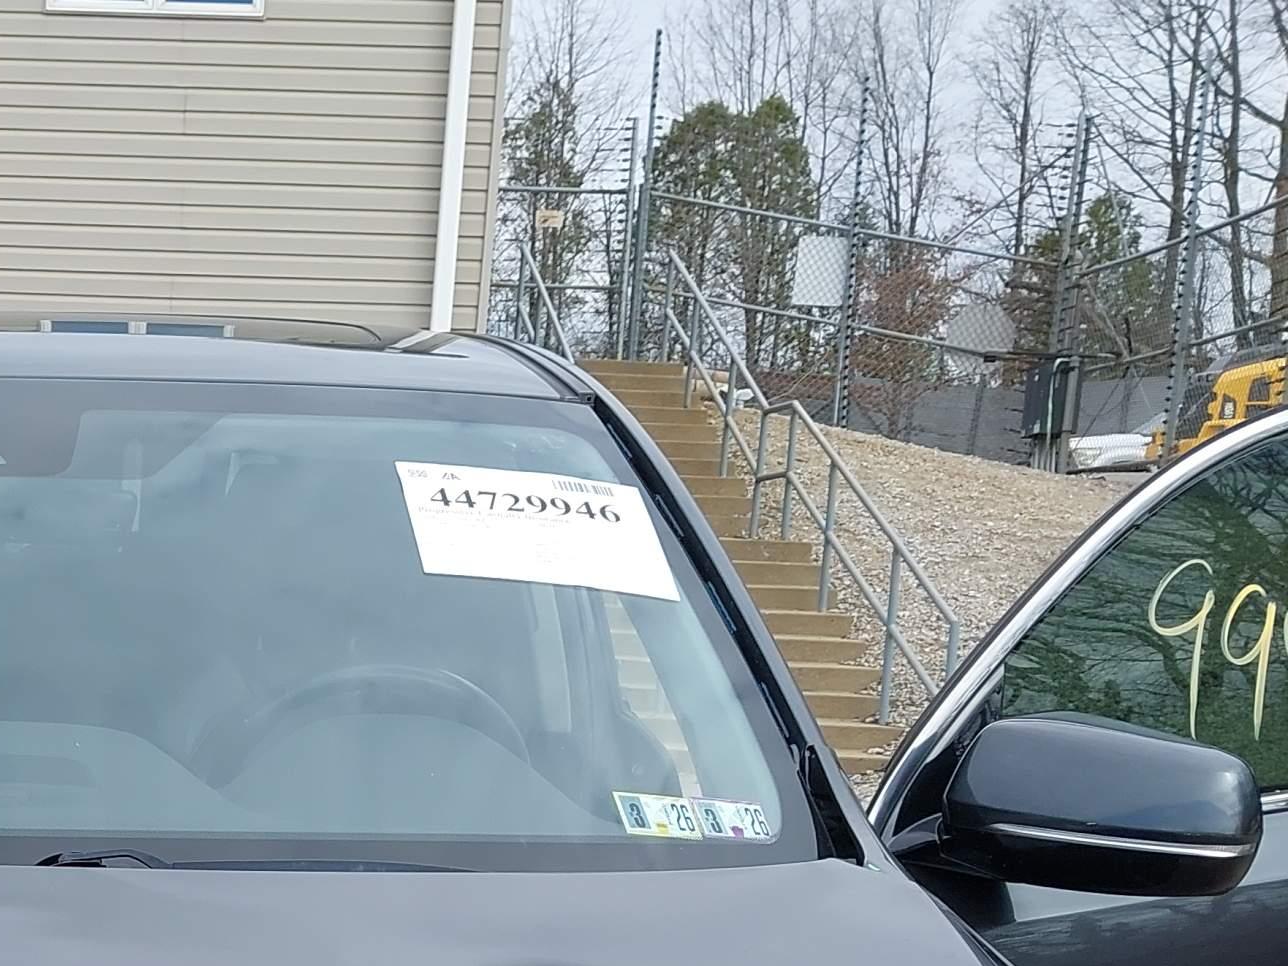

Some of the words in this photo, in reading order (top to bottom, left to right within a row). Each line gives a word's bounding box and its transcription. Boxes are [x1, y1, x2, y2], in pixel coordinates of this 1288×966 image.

[430, 487, 622, 524] 44729946
[1148, 558, 1288, 741] 99
[670, 803, 696, 832] 26
[744, 807, 770, 836] 26
